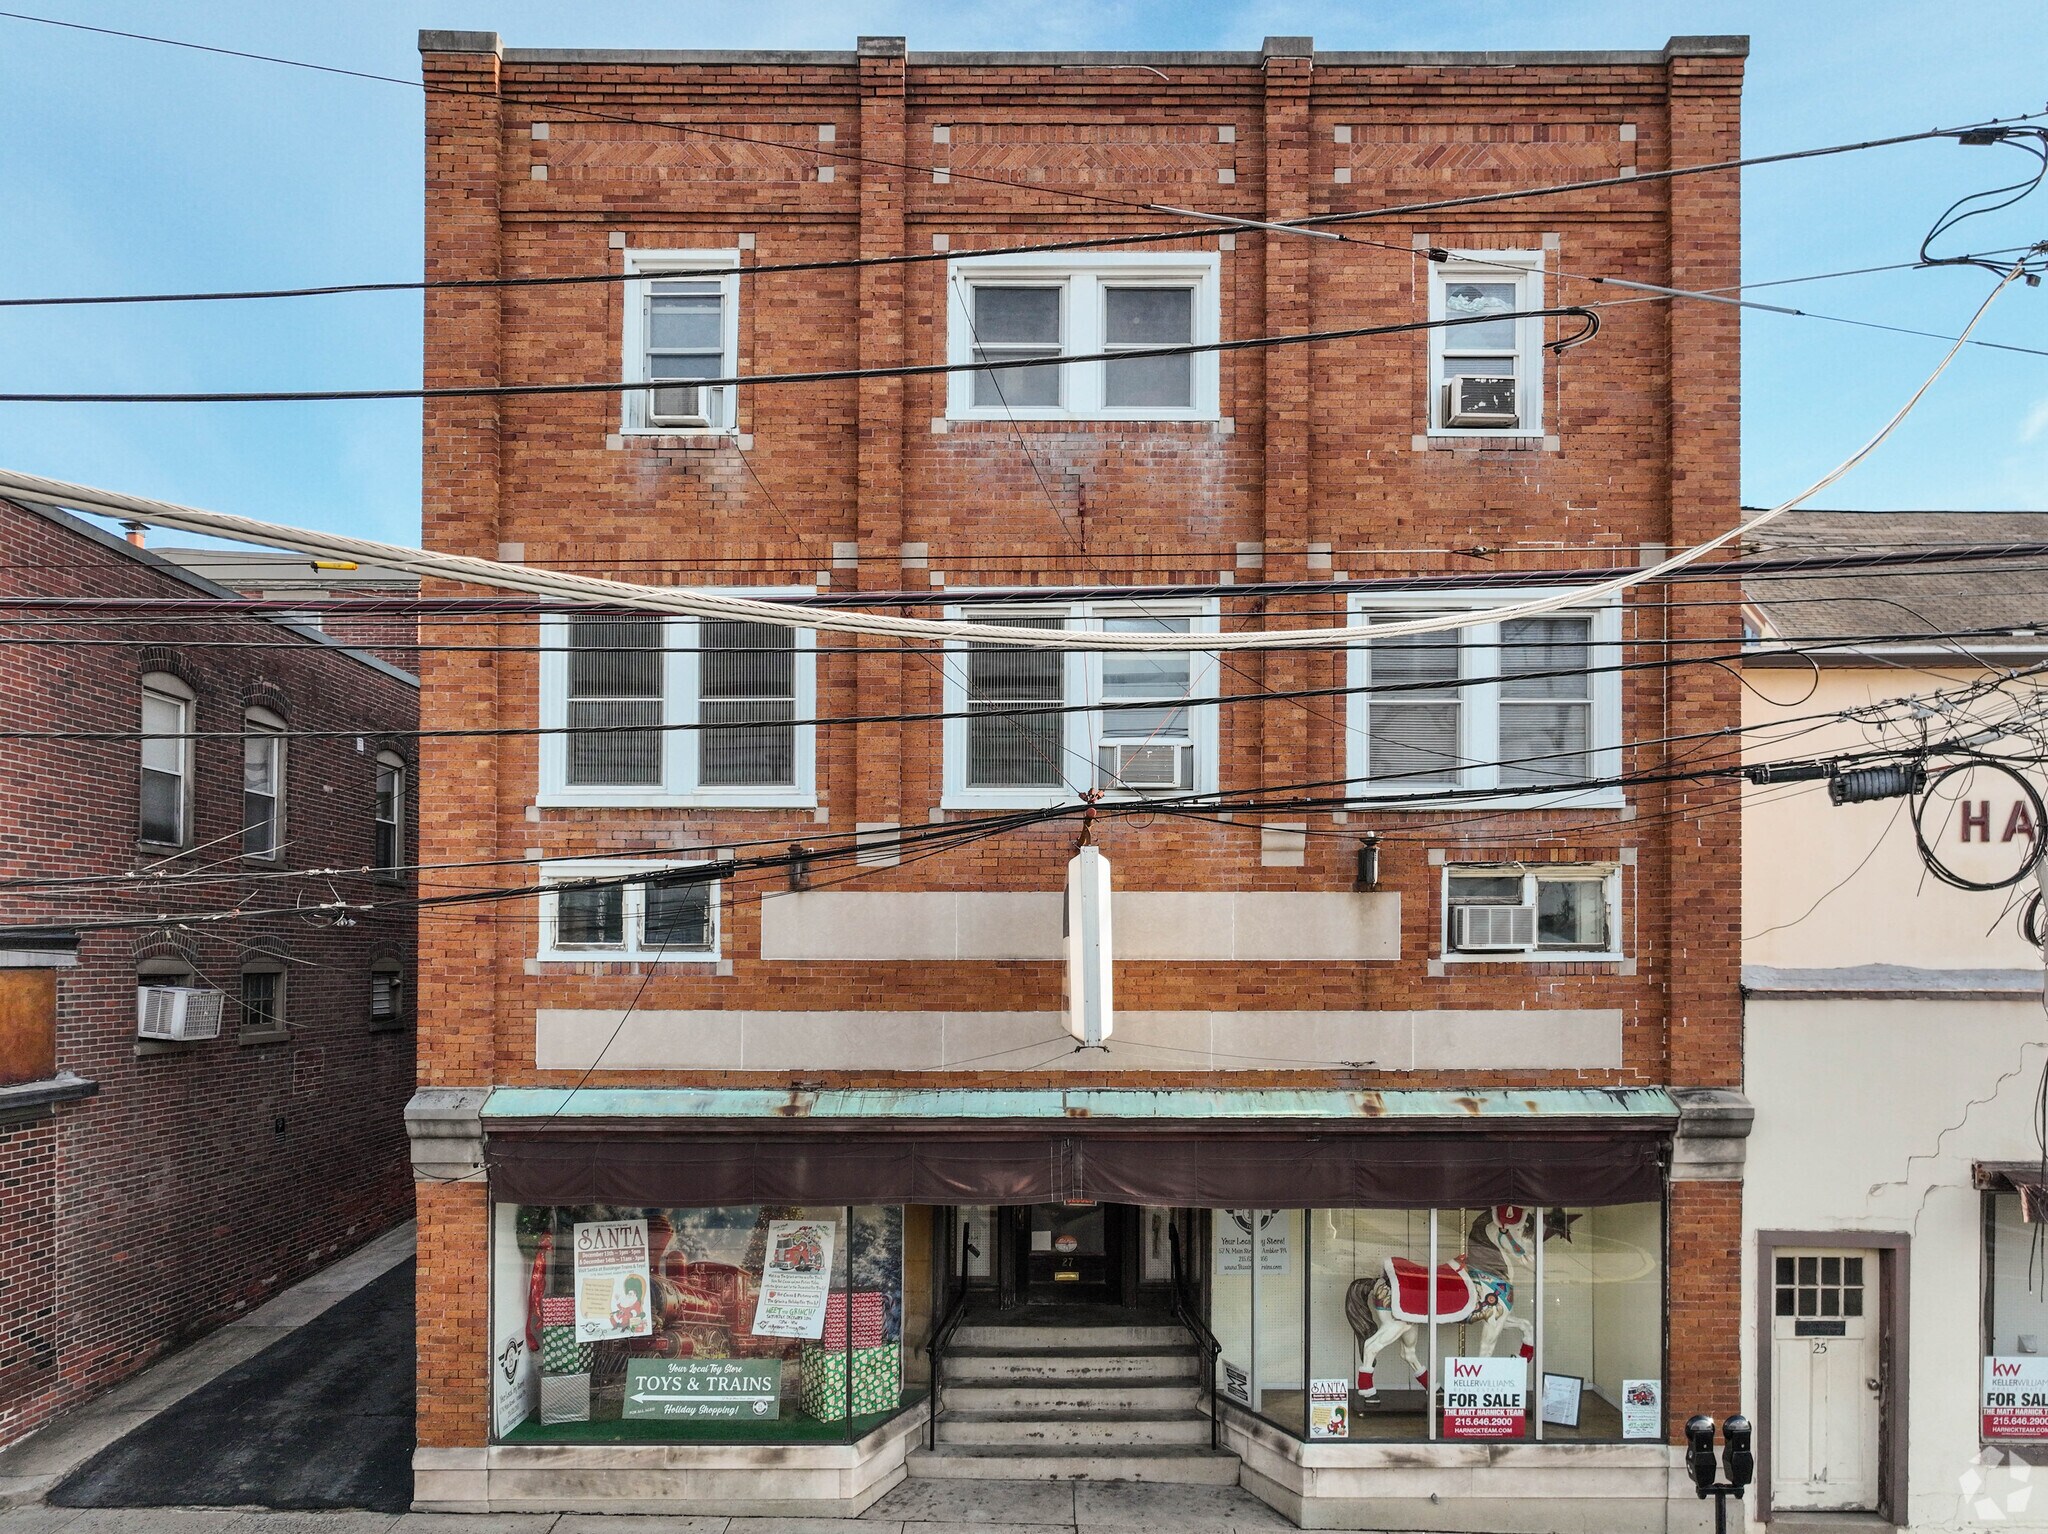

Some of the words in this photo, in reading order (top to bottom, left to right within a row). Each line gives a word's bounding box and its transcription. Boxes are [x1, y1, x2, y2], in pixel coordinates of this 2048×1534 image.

[1961, 800, 2048, 843] HA
[578, 1225, 645, 1250] SANTA
[1062, 1257, 1074, 1267] 27
[1812, 1342, 1828, 1354] 25
[668, 1363, 687, 1374] Your
[688, 1363, 708, 1374] Local
[709, 1363, 723, 1376] Toy
[724, 1363, 743, 1374] Store
[1454, 1358, 1483, 1377] kw
[1993, 1357, 2022, 1377] kw
[635, 1375, 682, 1392] TOYS
[687, 1376, 700, 1391] &
[706, 1376, 773, 1392] TRAINS
[1311, 1382, 1347, 1394] SANTA
[1992, 1379, 2048, 1387] KELLERWILLIAM
[1448, 1393, 1477, 1407] FOR
[1482, 1393, 1520, 1407] SALE
[1986, 1392, 2016, 1406] FOR
[2021, 1392, 2048, 1406] SAL
[664, 1403, 697, 1416] Holiday
[698, 1403, 740, 1417] Shopping!
[1445, 1409, 1457, 1417] THE
[1458, 1409, 1476, 1417] MATT
[1476, 1409, 1505, 1417] HARNICK
[1505, 1409, 1524, 1417] TEAM
[1996, 1408, 2014, 1416] MATT
[2015, 1408, 2043, 1416] HARNICK
[1455, 1417, 1513, 1426] 215.646.2900
